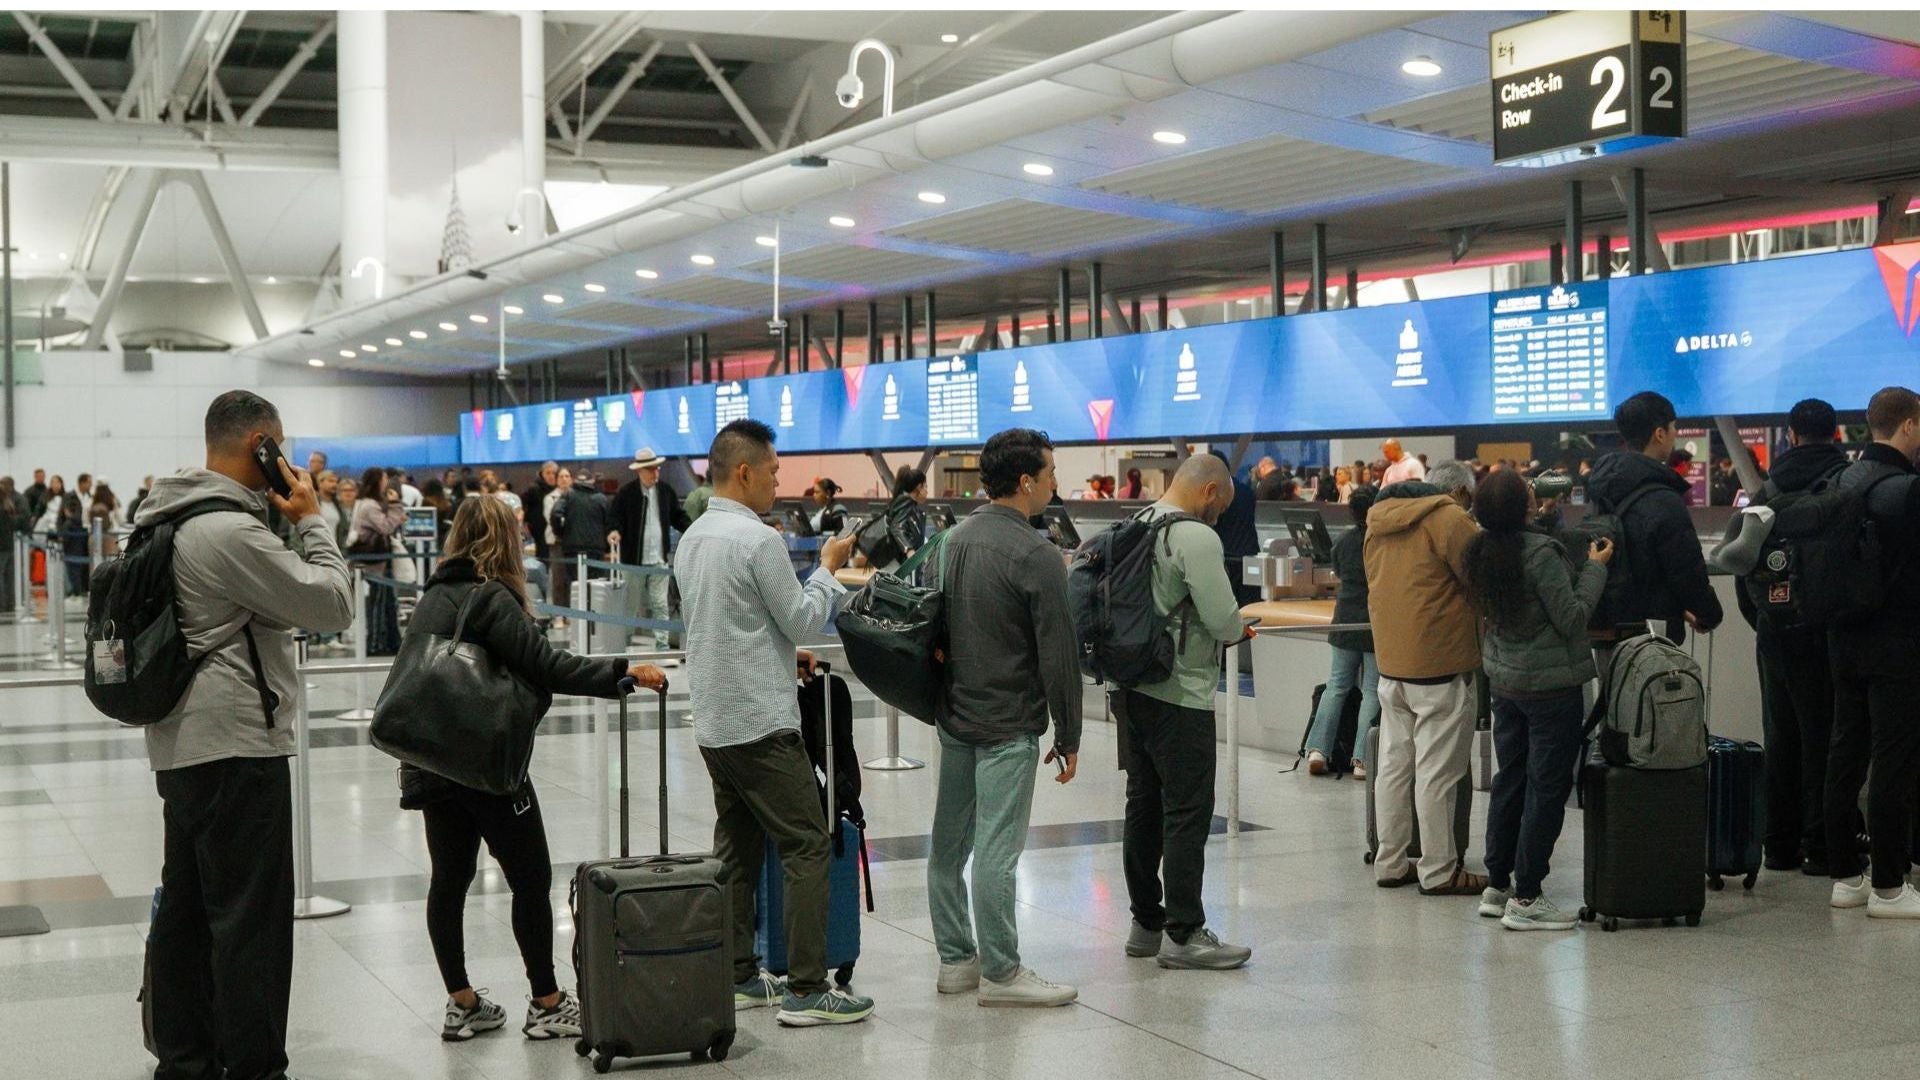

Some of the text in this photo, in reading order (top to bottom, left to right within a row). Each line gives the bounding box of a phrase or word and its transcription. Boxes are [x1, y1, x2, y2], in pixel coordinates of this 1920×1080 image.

[1501, 72, 1563, 103] Check-in
[1590, 55, 1626, 130] 2
[1650, 66, 1674, 109] 2
[1502, 108, 1532, 129] Row
[1690, 333, 1739, 351] DELTA
